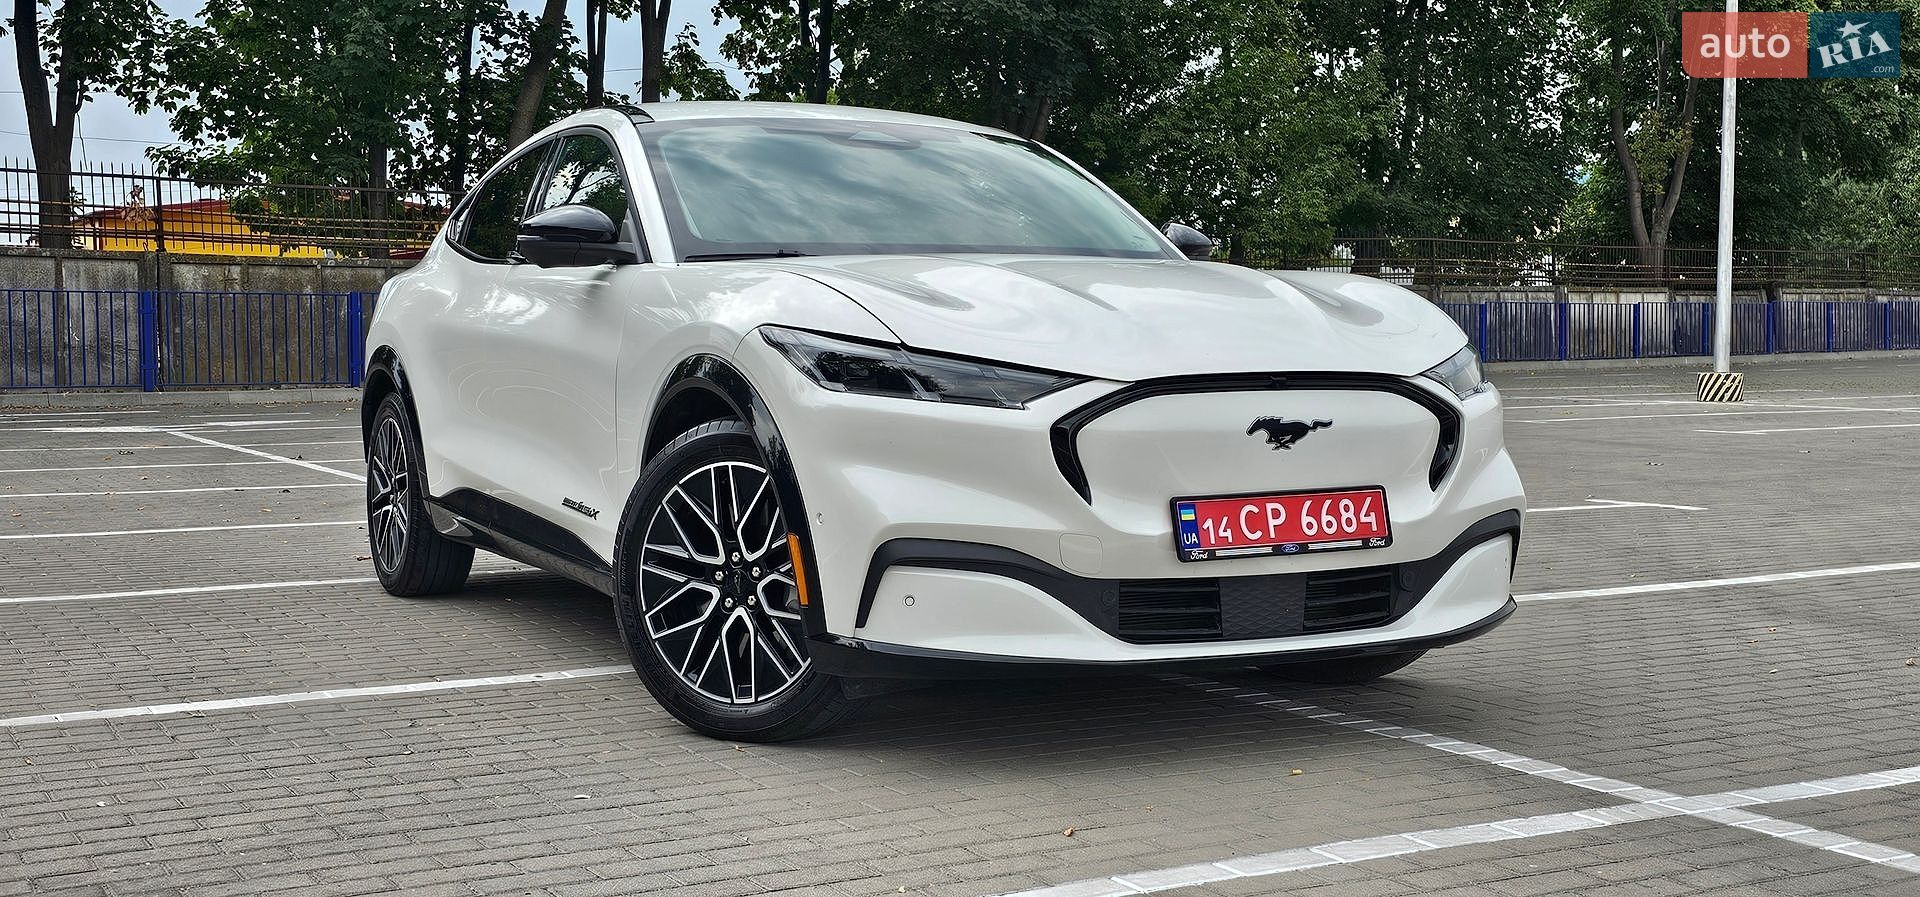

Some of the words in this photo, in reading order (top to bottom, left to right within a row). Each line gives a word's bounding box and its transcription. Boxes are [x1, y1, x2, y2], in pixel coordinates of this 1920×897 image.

[1202, 516, 1233, 545] 14
[1239, 502, 1287, 541] CP
[1301, 496, 1378, 536] 6684
[1184, 533, 1199, 544] UA
[1369, 537, 1386, 547] Ford
[1190, 550, 1208, 560] Ford
